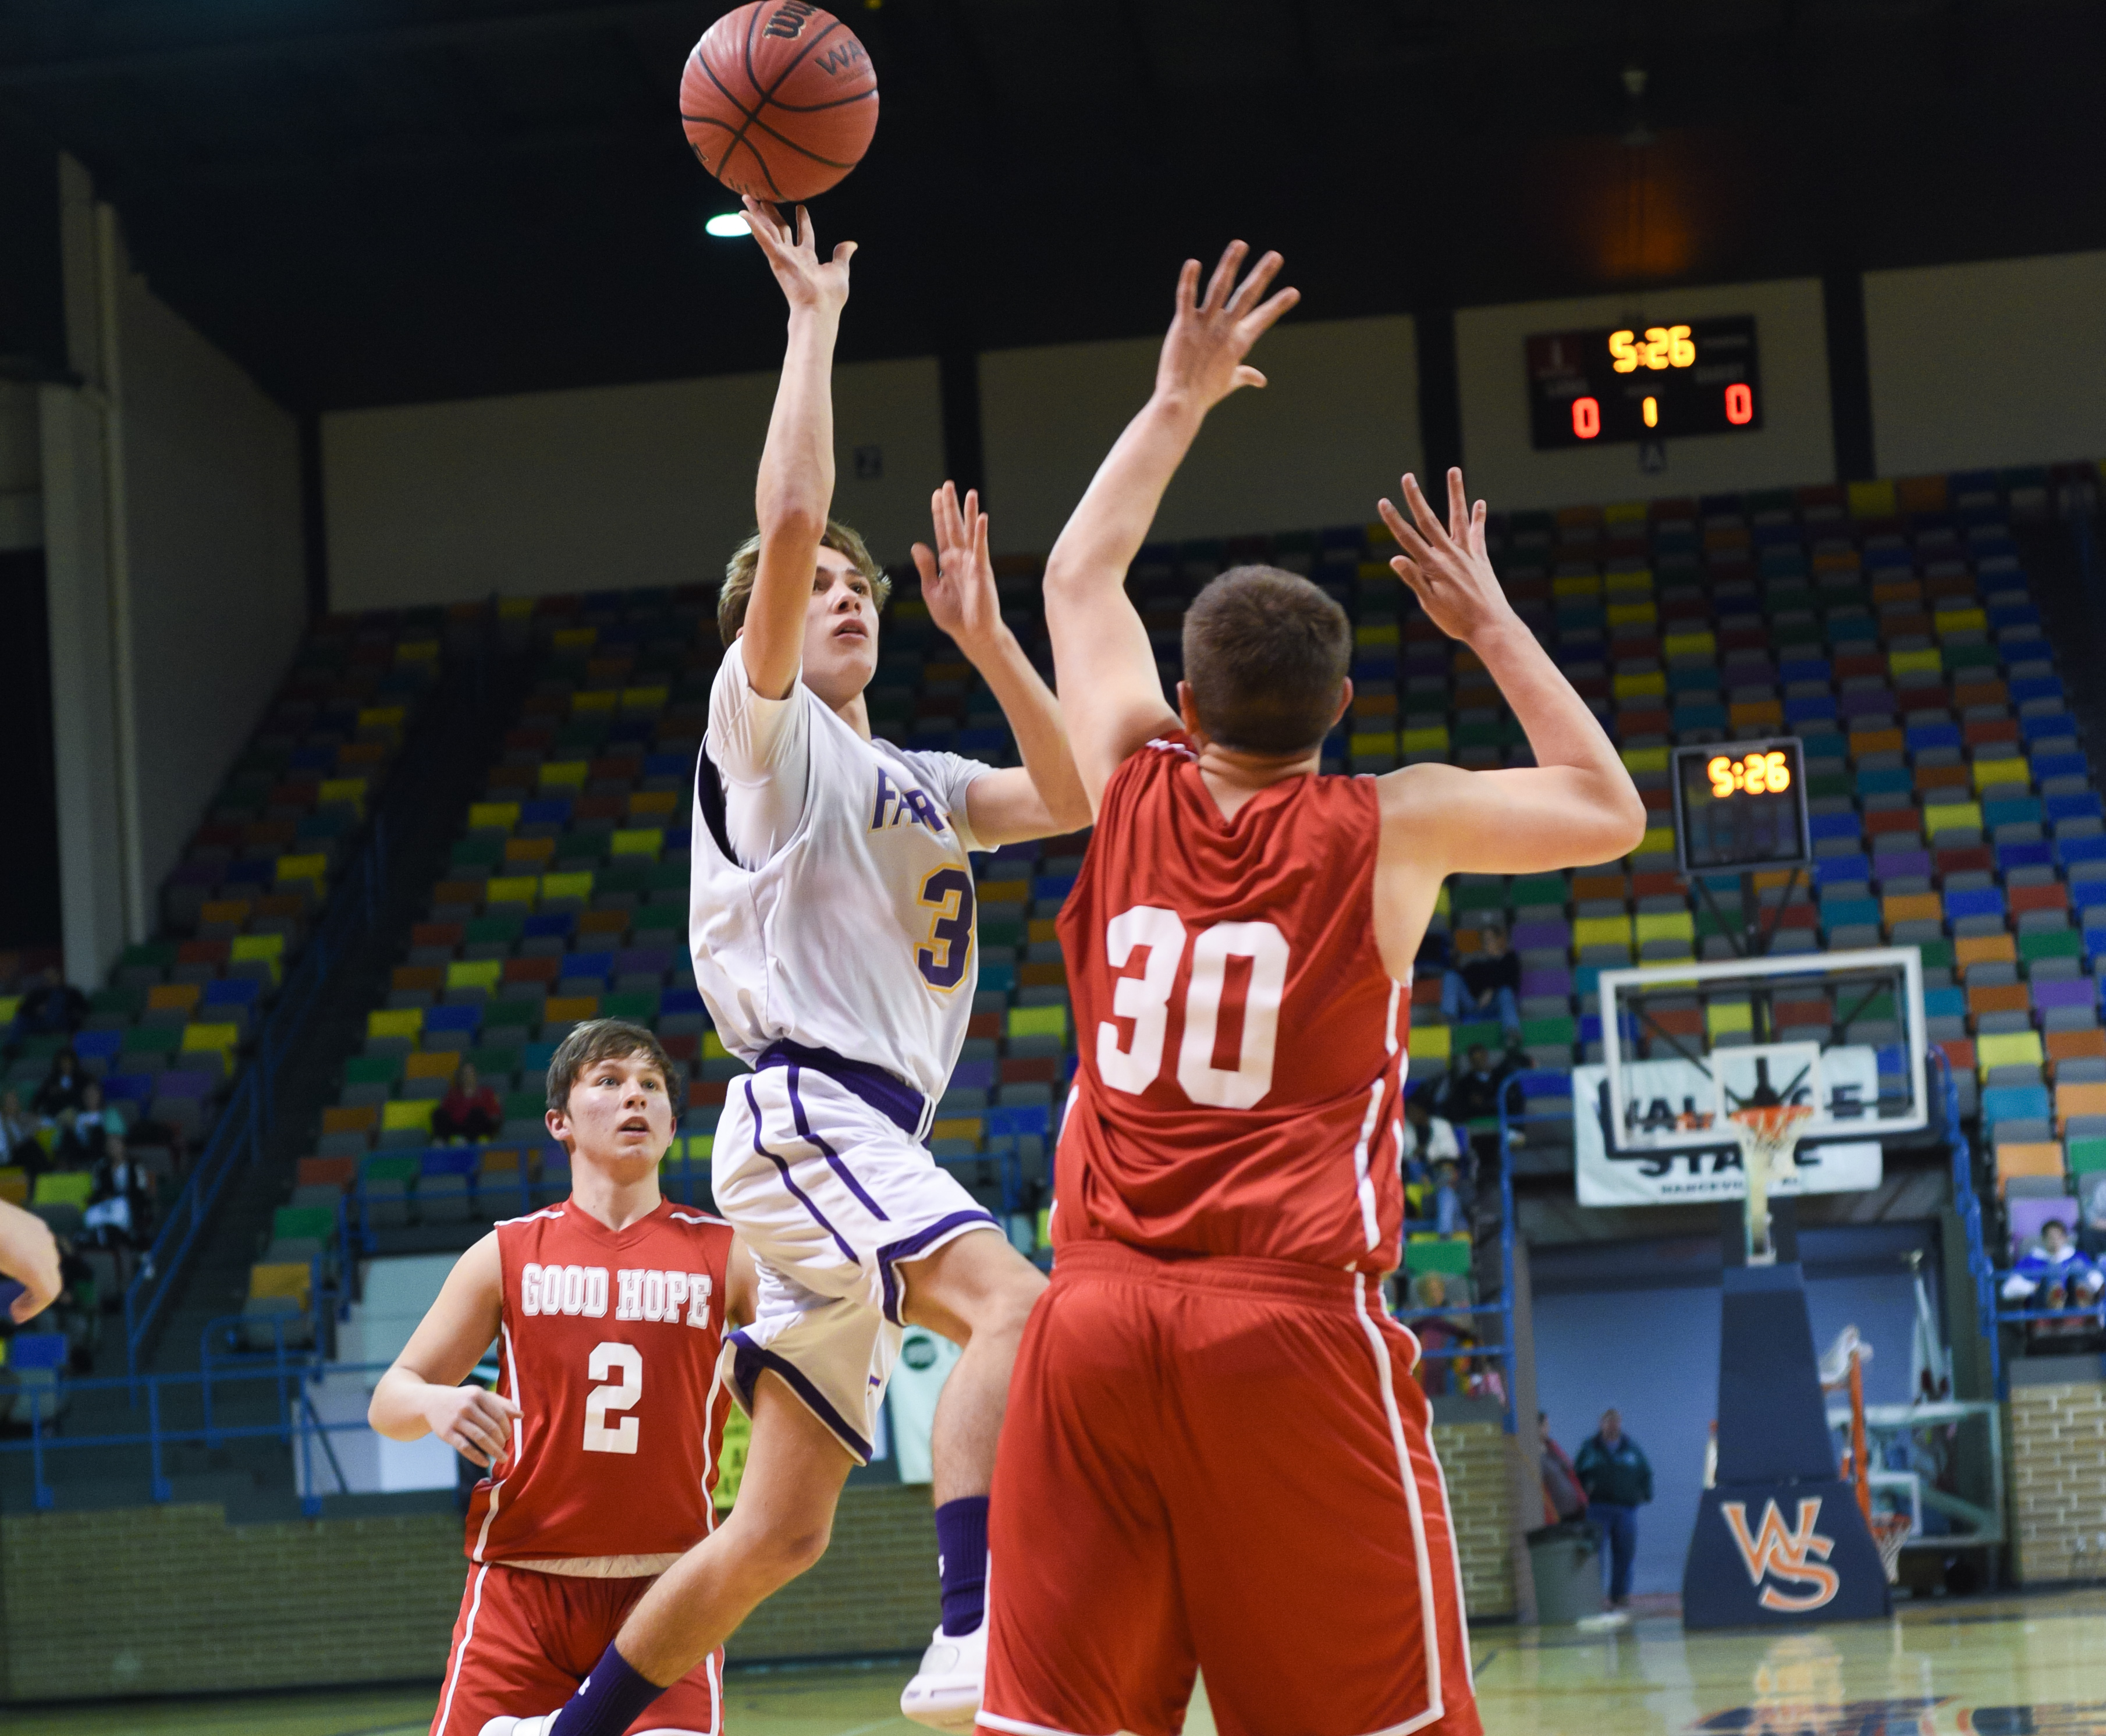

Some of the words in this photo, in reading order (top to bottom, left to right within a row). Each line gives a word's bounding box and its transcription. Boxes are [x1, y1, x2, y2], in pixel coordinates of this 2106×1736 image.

[1609, 325, 1695, 373] 5:26
[1572, 397, 1600, 439] 0
[1643, 396, 1658, 428] 1
[1725, 383, 1752, 425] 0
[1707, 751, 1790, 798] 5:26
[914, 862, 975, 993] 3
[1096, 905, 1290, 1110] 30
[521, 1263, 609, 1318] GOOD
[616, 1269, 712, 1330] HOPE
[583, 1342, 642, 1454] 2
[1721, 1494, 1840, 1613] WS
